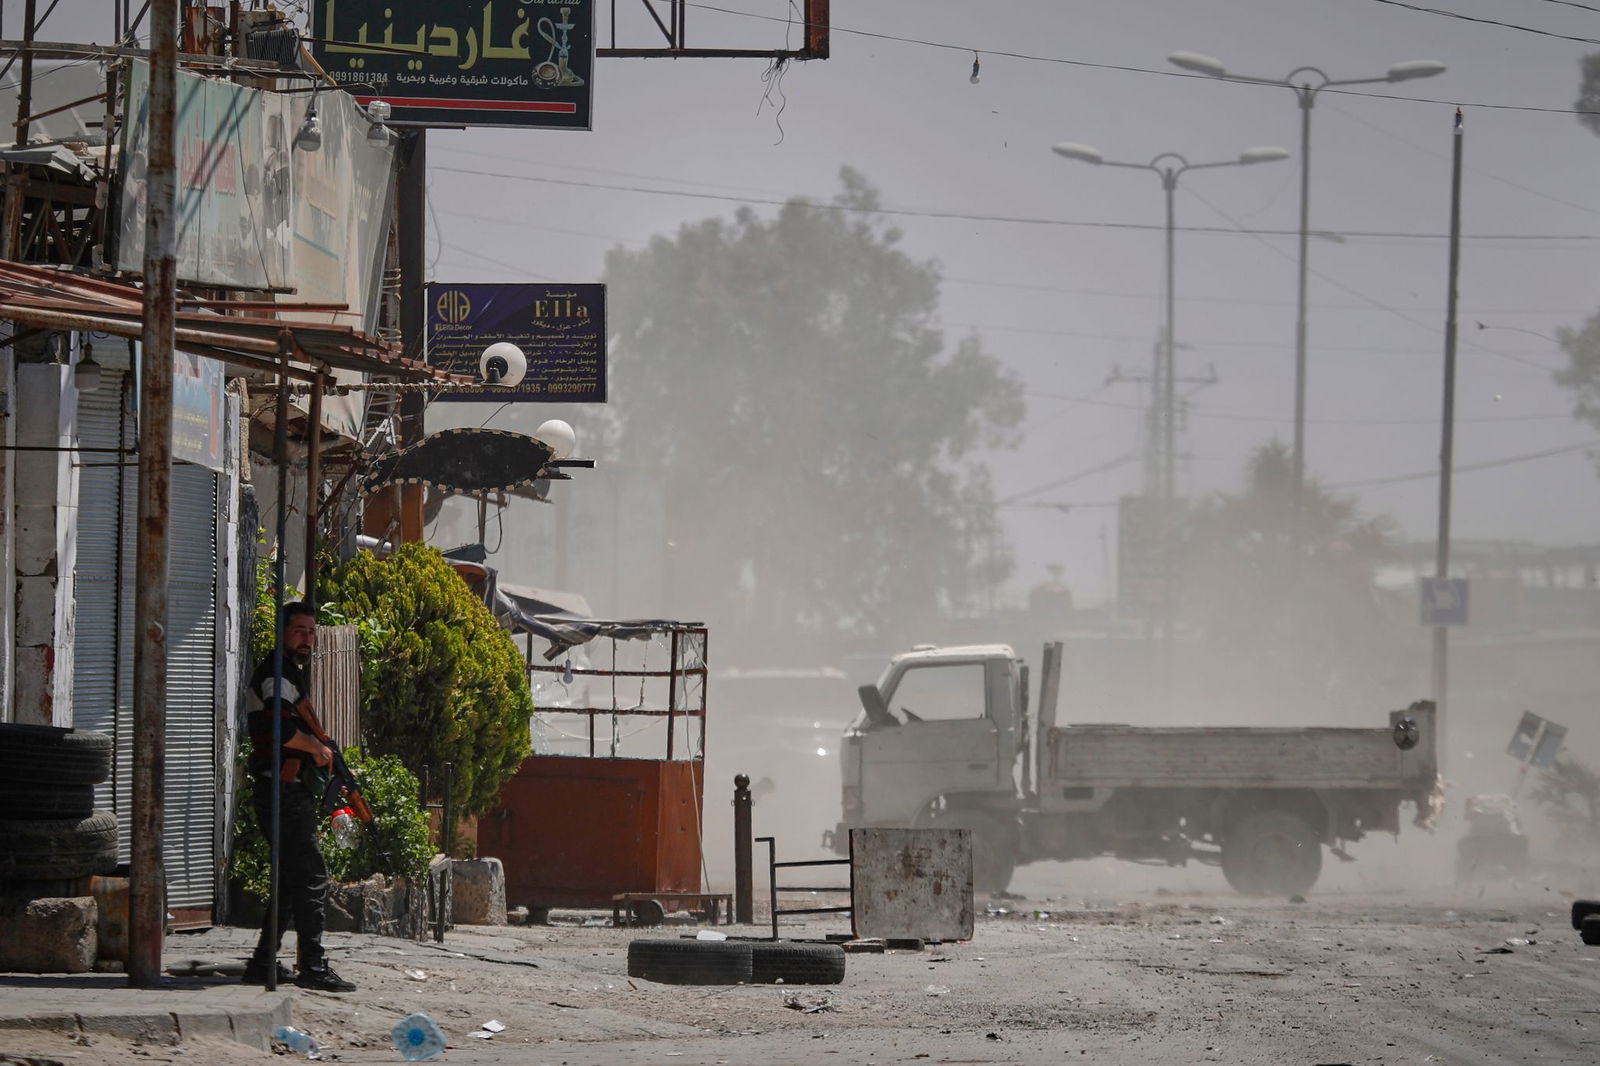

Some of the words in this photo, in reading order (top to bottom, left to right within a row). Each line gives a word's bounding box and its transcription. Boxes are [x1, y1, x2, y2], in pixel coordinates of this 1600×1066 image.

[325, 0, 531, 70] غاردينيا
[329, 71, 387, 82] 0991861384
[396, 73, 426, 84] وبحرية
[429, 74, 457, 85] وغربية
[460, 74, 488, 86] شرقية
[491, 75, 528, 87] مأكولات
[535, 300, 588, 318] Ella
[547, 383, 597, 393] 0993290777
